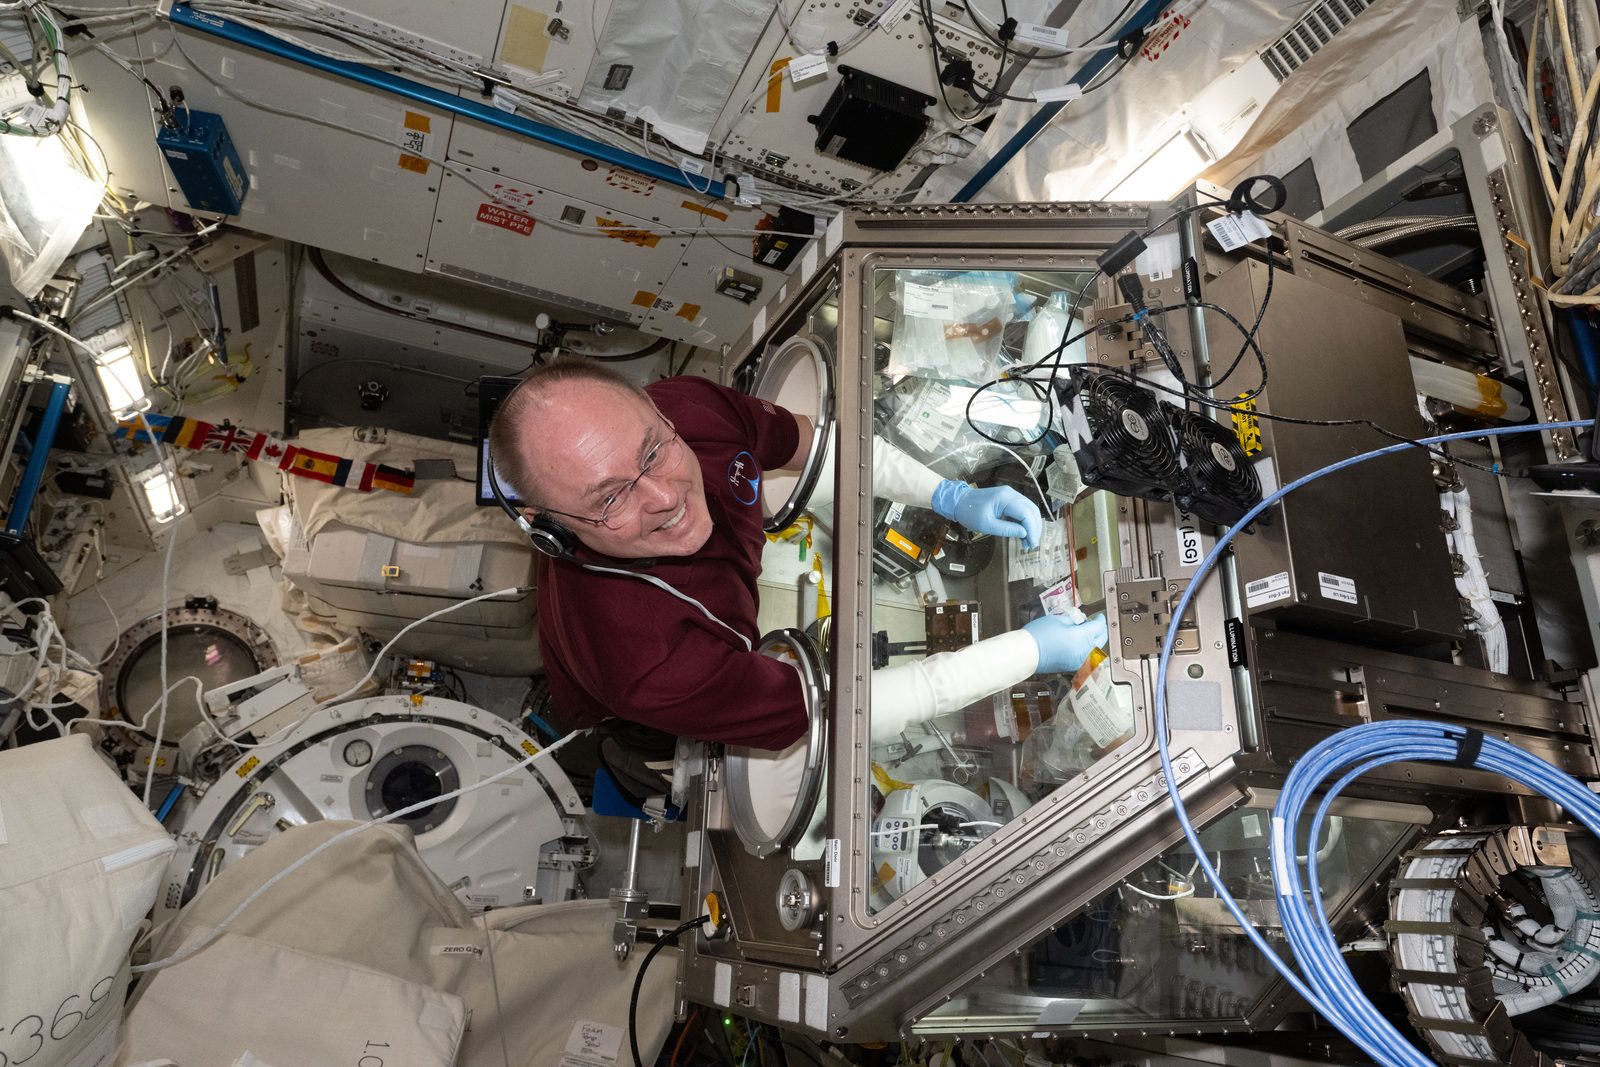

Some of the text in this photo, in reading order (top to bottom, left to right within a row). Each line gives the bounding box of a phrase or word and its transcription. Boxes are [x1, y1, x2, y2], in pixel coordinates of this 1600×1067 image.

[614, 173, 631, 182] FIRE
[630, 178, 649, 188] PORT
[503, 194, 522, 203] FIRE
[479, 213, 531, 234] MIST PFE
[487, 206, 529, 225] WATER
[1245, 402, 1253, 429] WANING
[1179, 526, 1199, 564] (LSG)
[1228, 622, 1239, 663] ILLUMINATION
